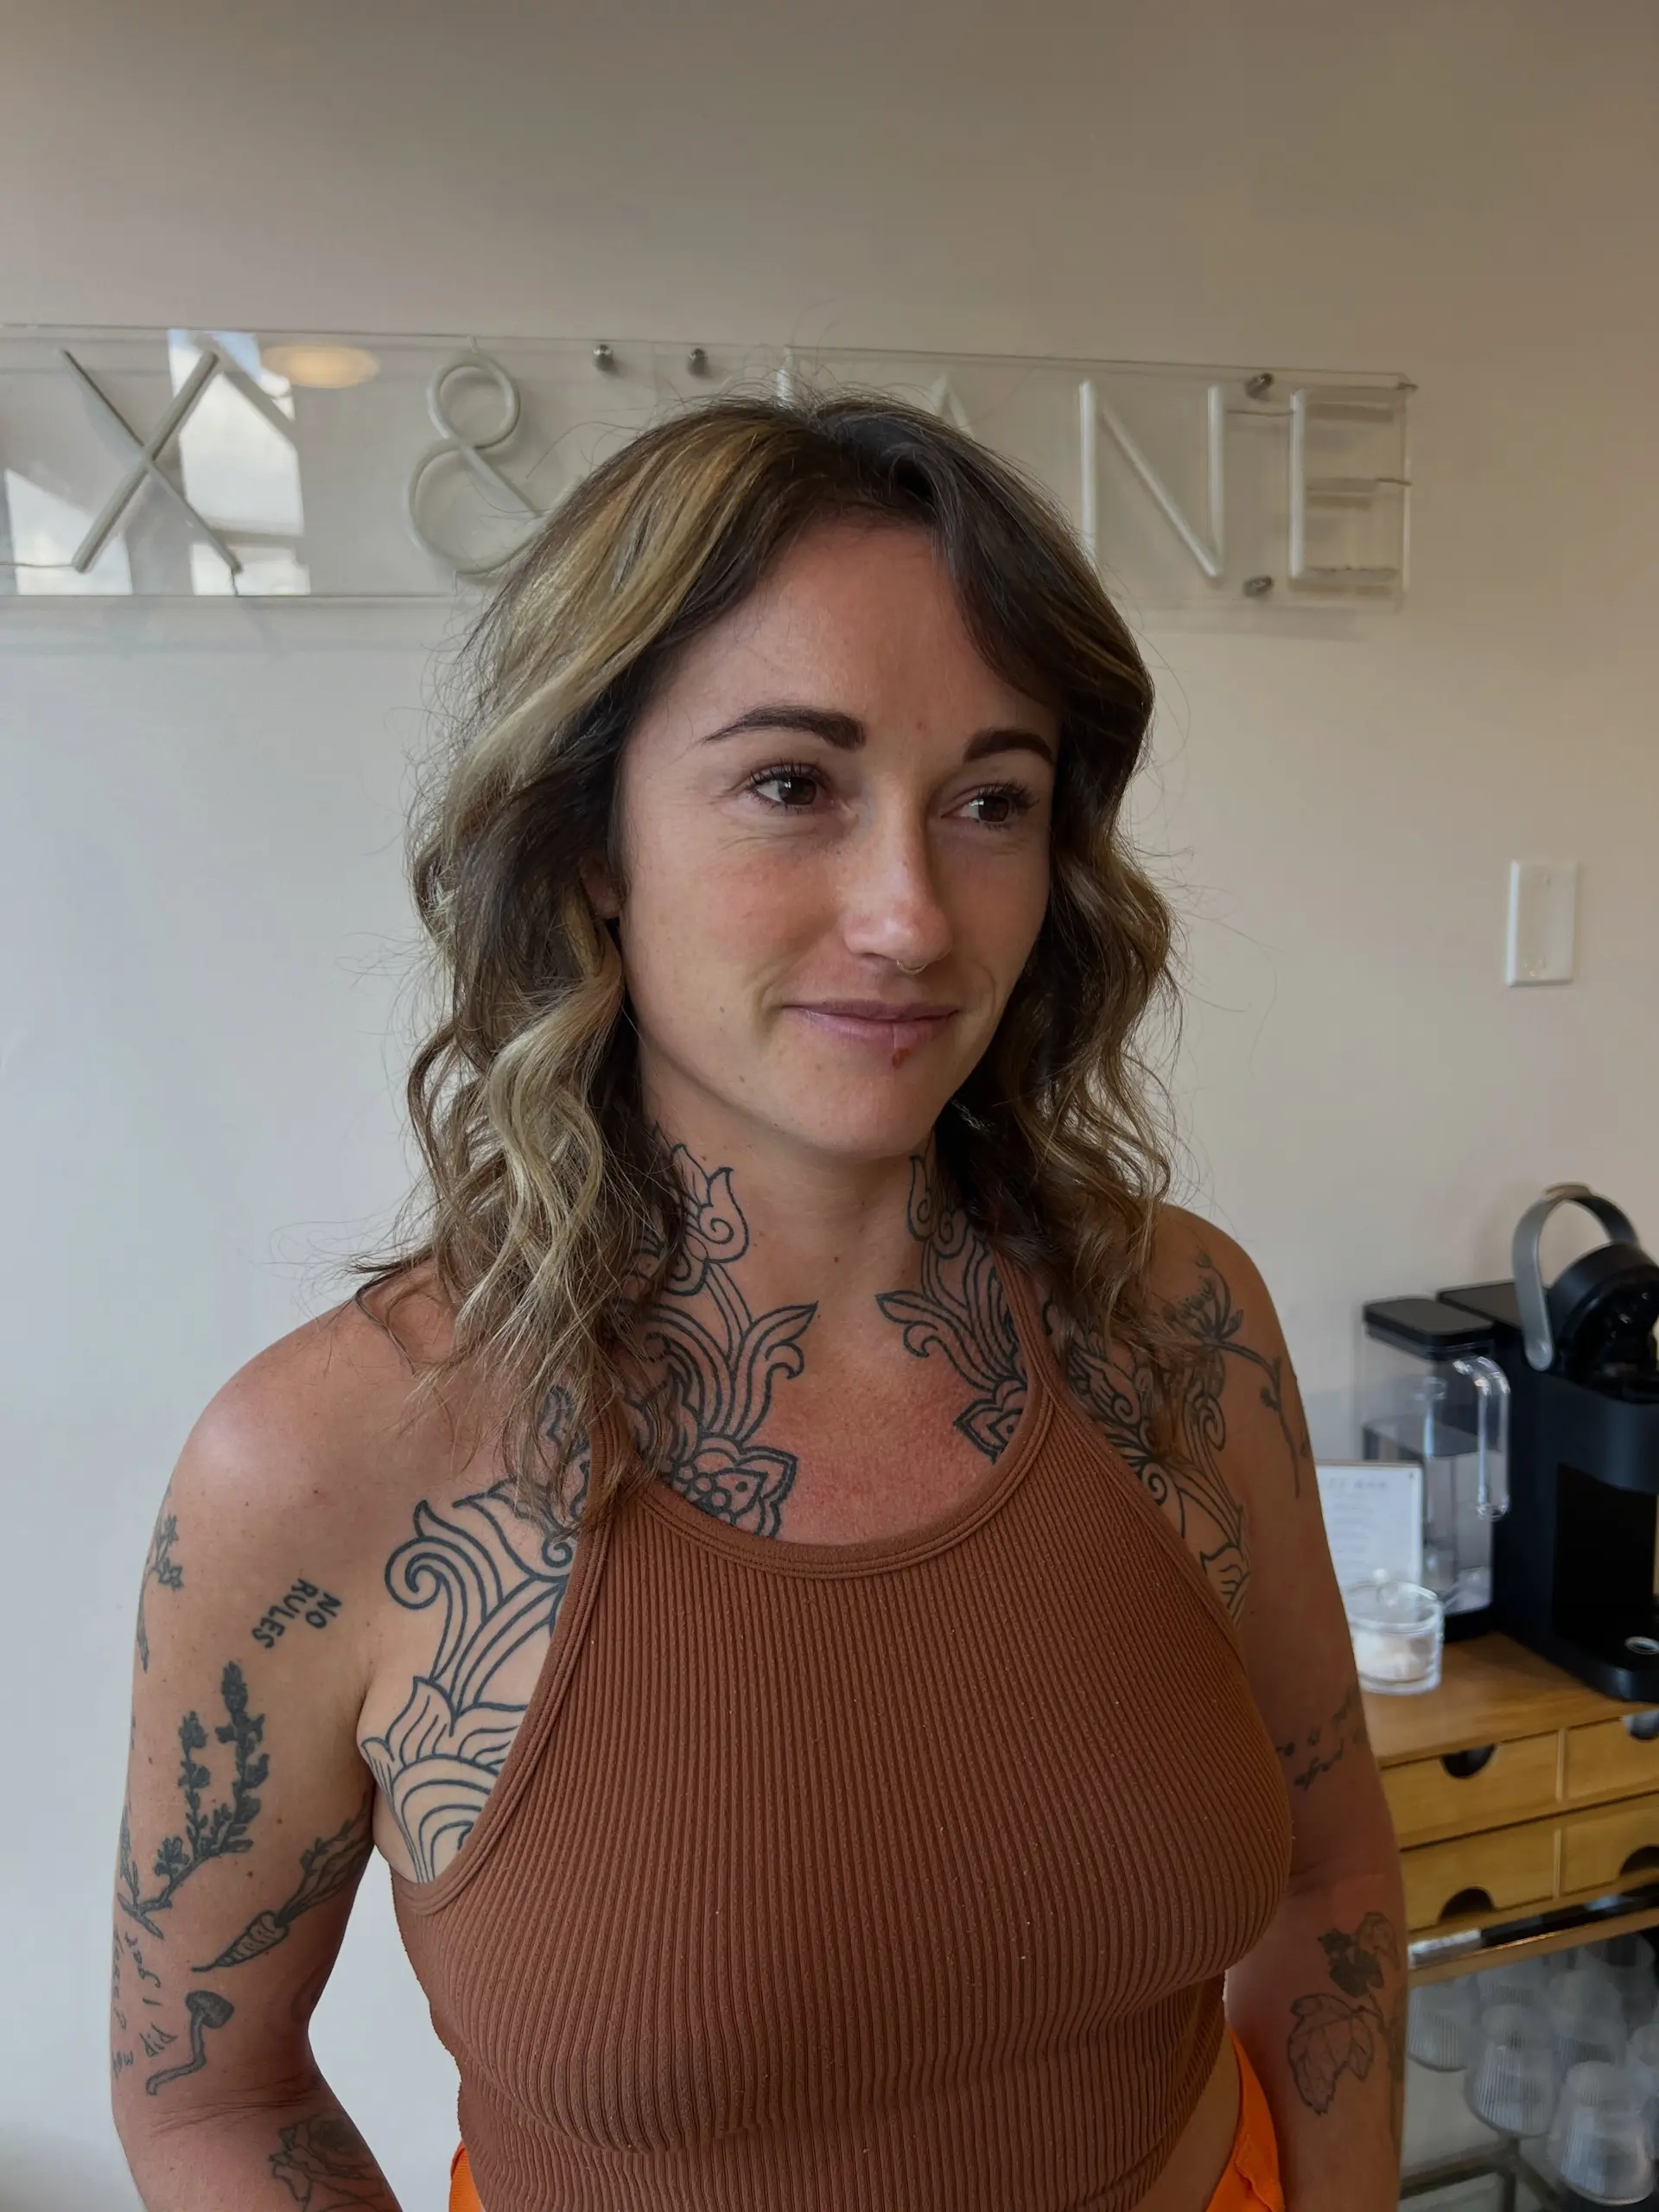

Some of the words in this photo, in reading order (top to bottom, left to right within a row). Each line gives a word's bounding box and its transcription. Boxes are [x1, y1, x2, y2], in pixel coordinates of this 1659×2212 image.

[60, 349, 244, 574] X
[251, 1578, 319, 1649] RULES
[305, 1592, 342, 1630] NO
